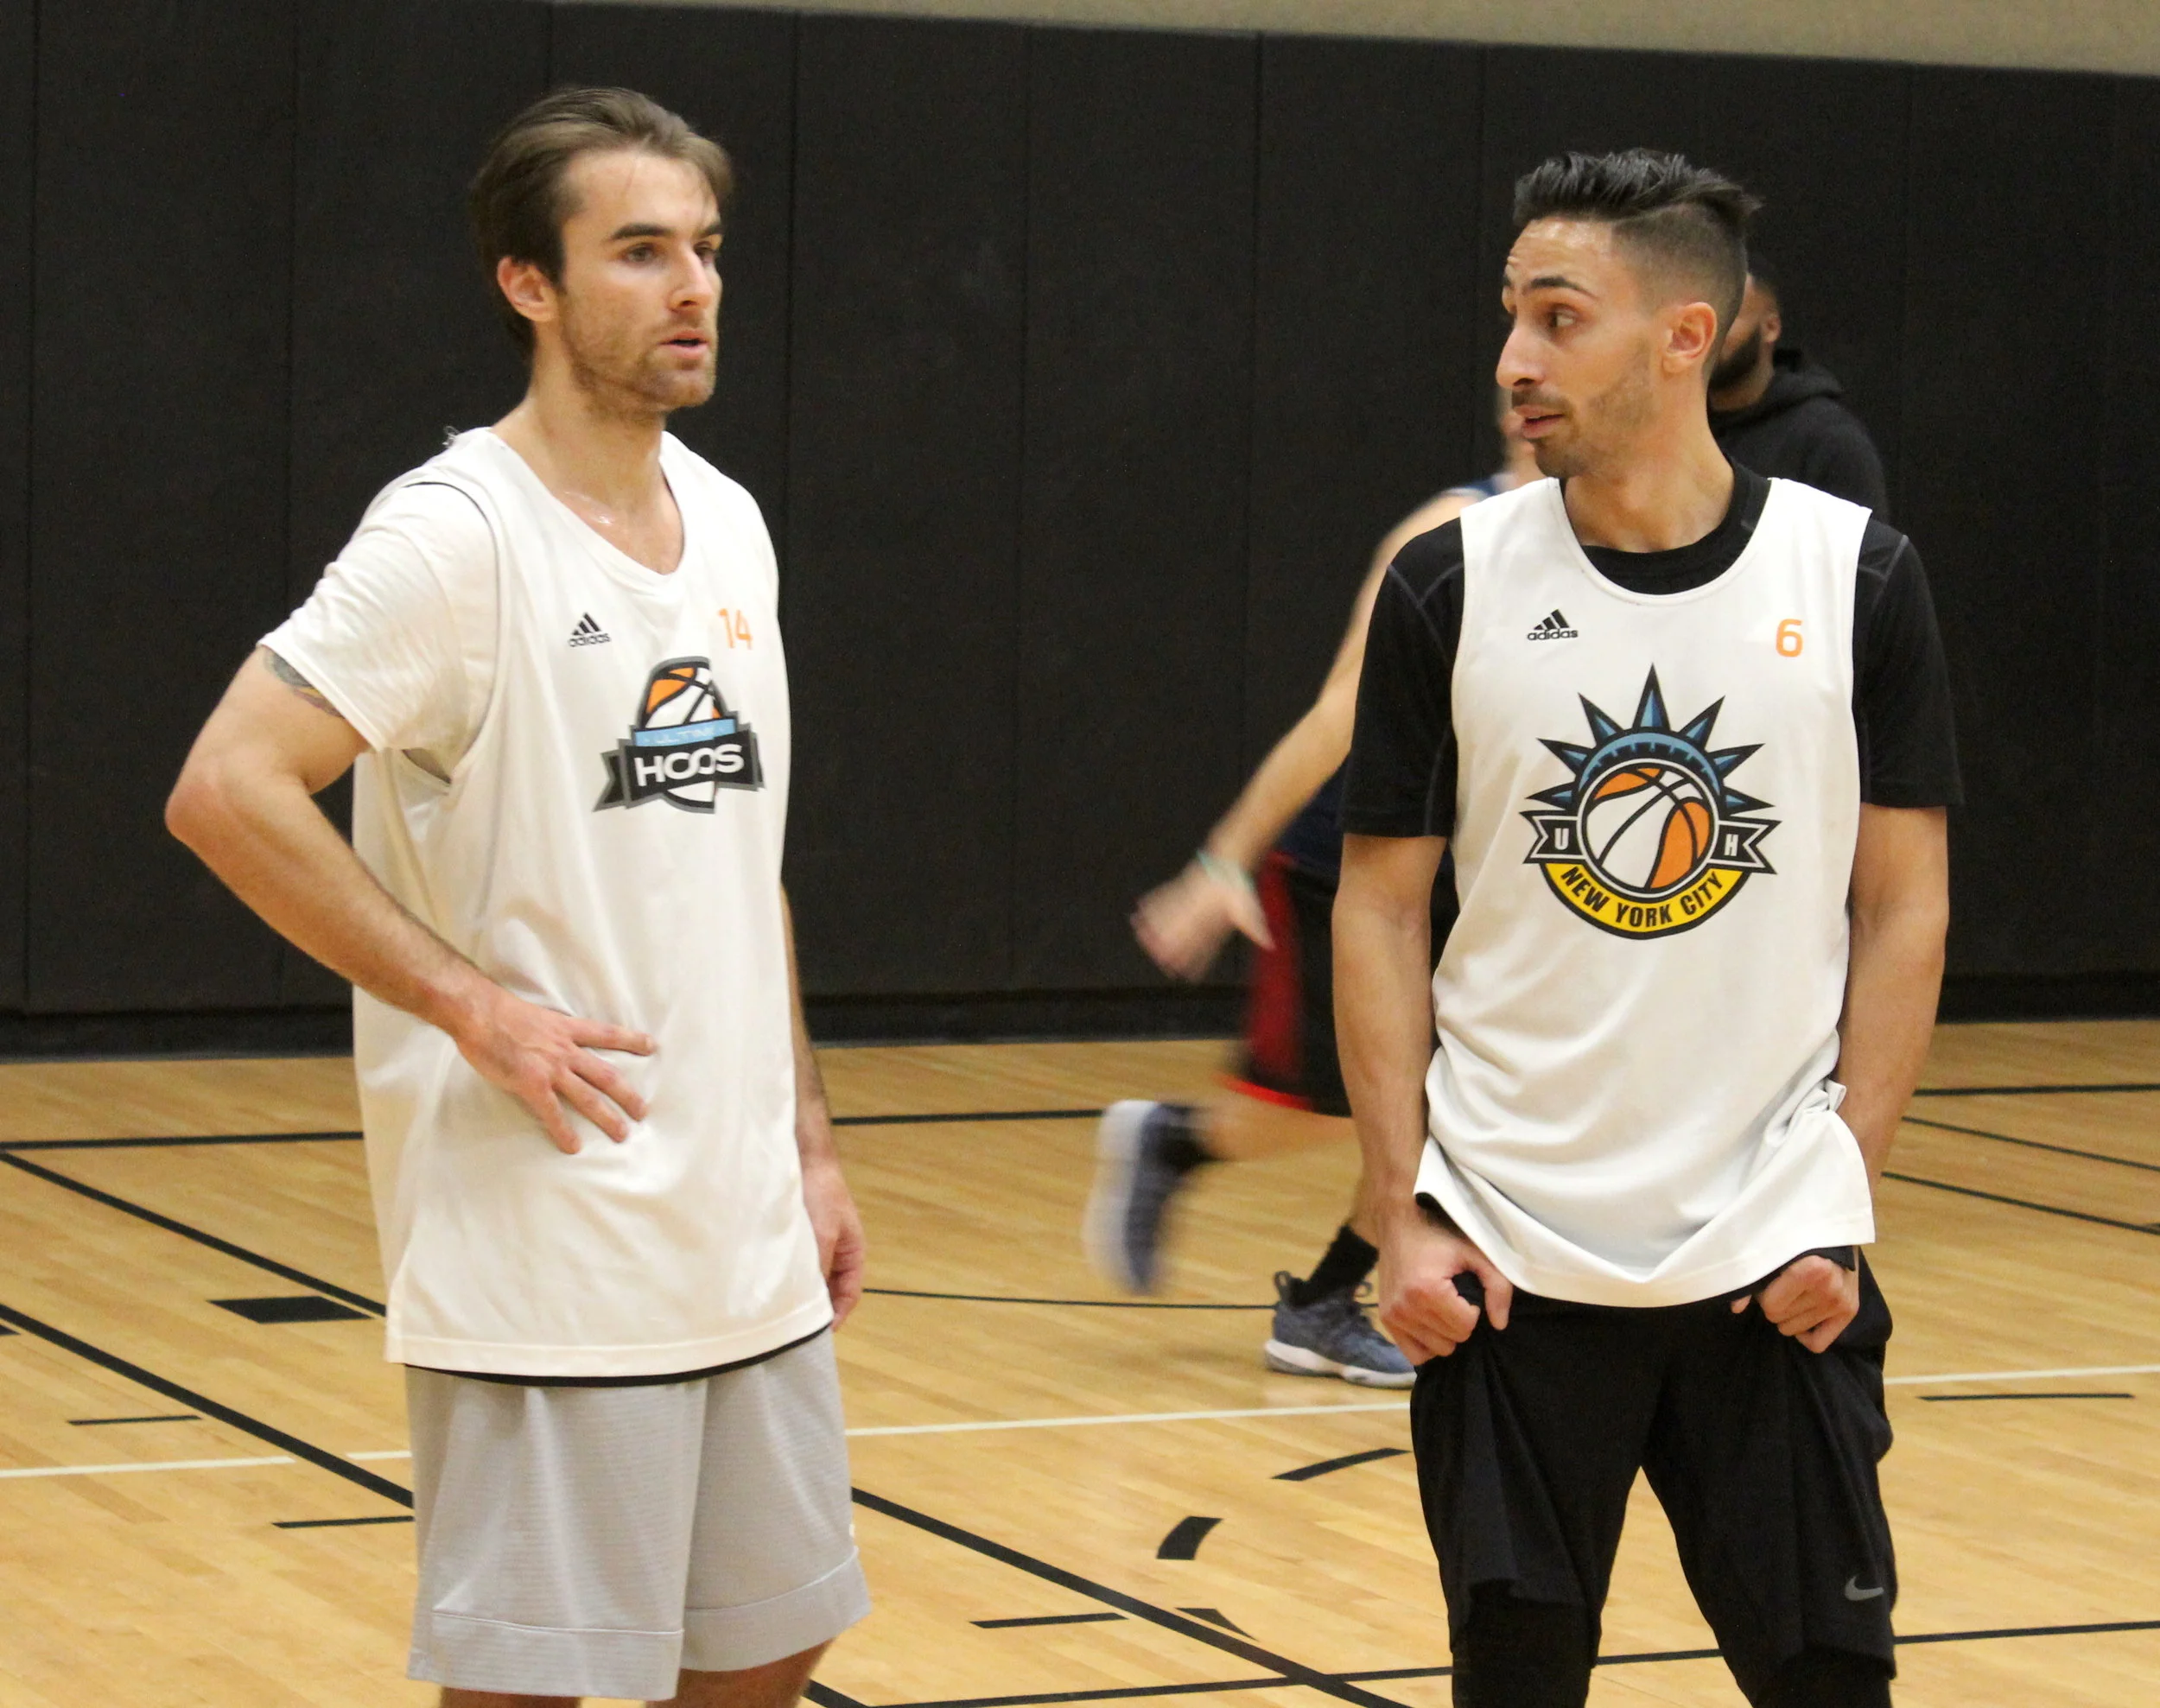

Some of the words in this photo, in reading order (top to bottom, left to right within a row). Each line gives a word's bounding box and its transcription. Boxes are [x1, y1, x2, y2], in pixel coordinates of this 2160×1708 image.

[568, 632, 611, 647] adidas
[718, 607, 753, 650] 14
[1527, 629, 1579, 640] adidas
[1776, 618, 1802, 657] 6
[633, 743, 745, 787] HOOS
[1554, 828, 1569, 850] U
[1724, 834, 1738, 856] H
[1560, 866, 1610, 913] NEW
[1615, 902, 1673, 928] YORK
[1679, 871, 1723, 916] CITY
